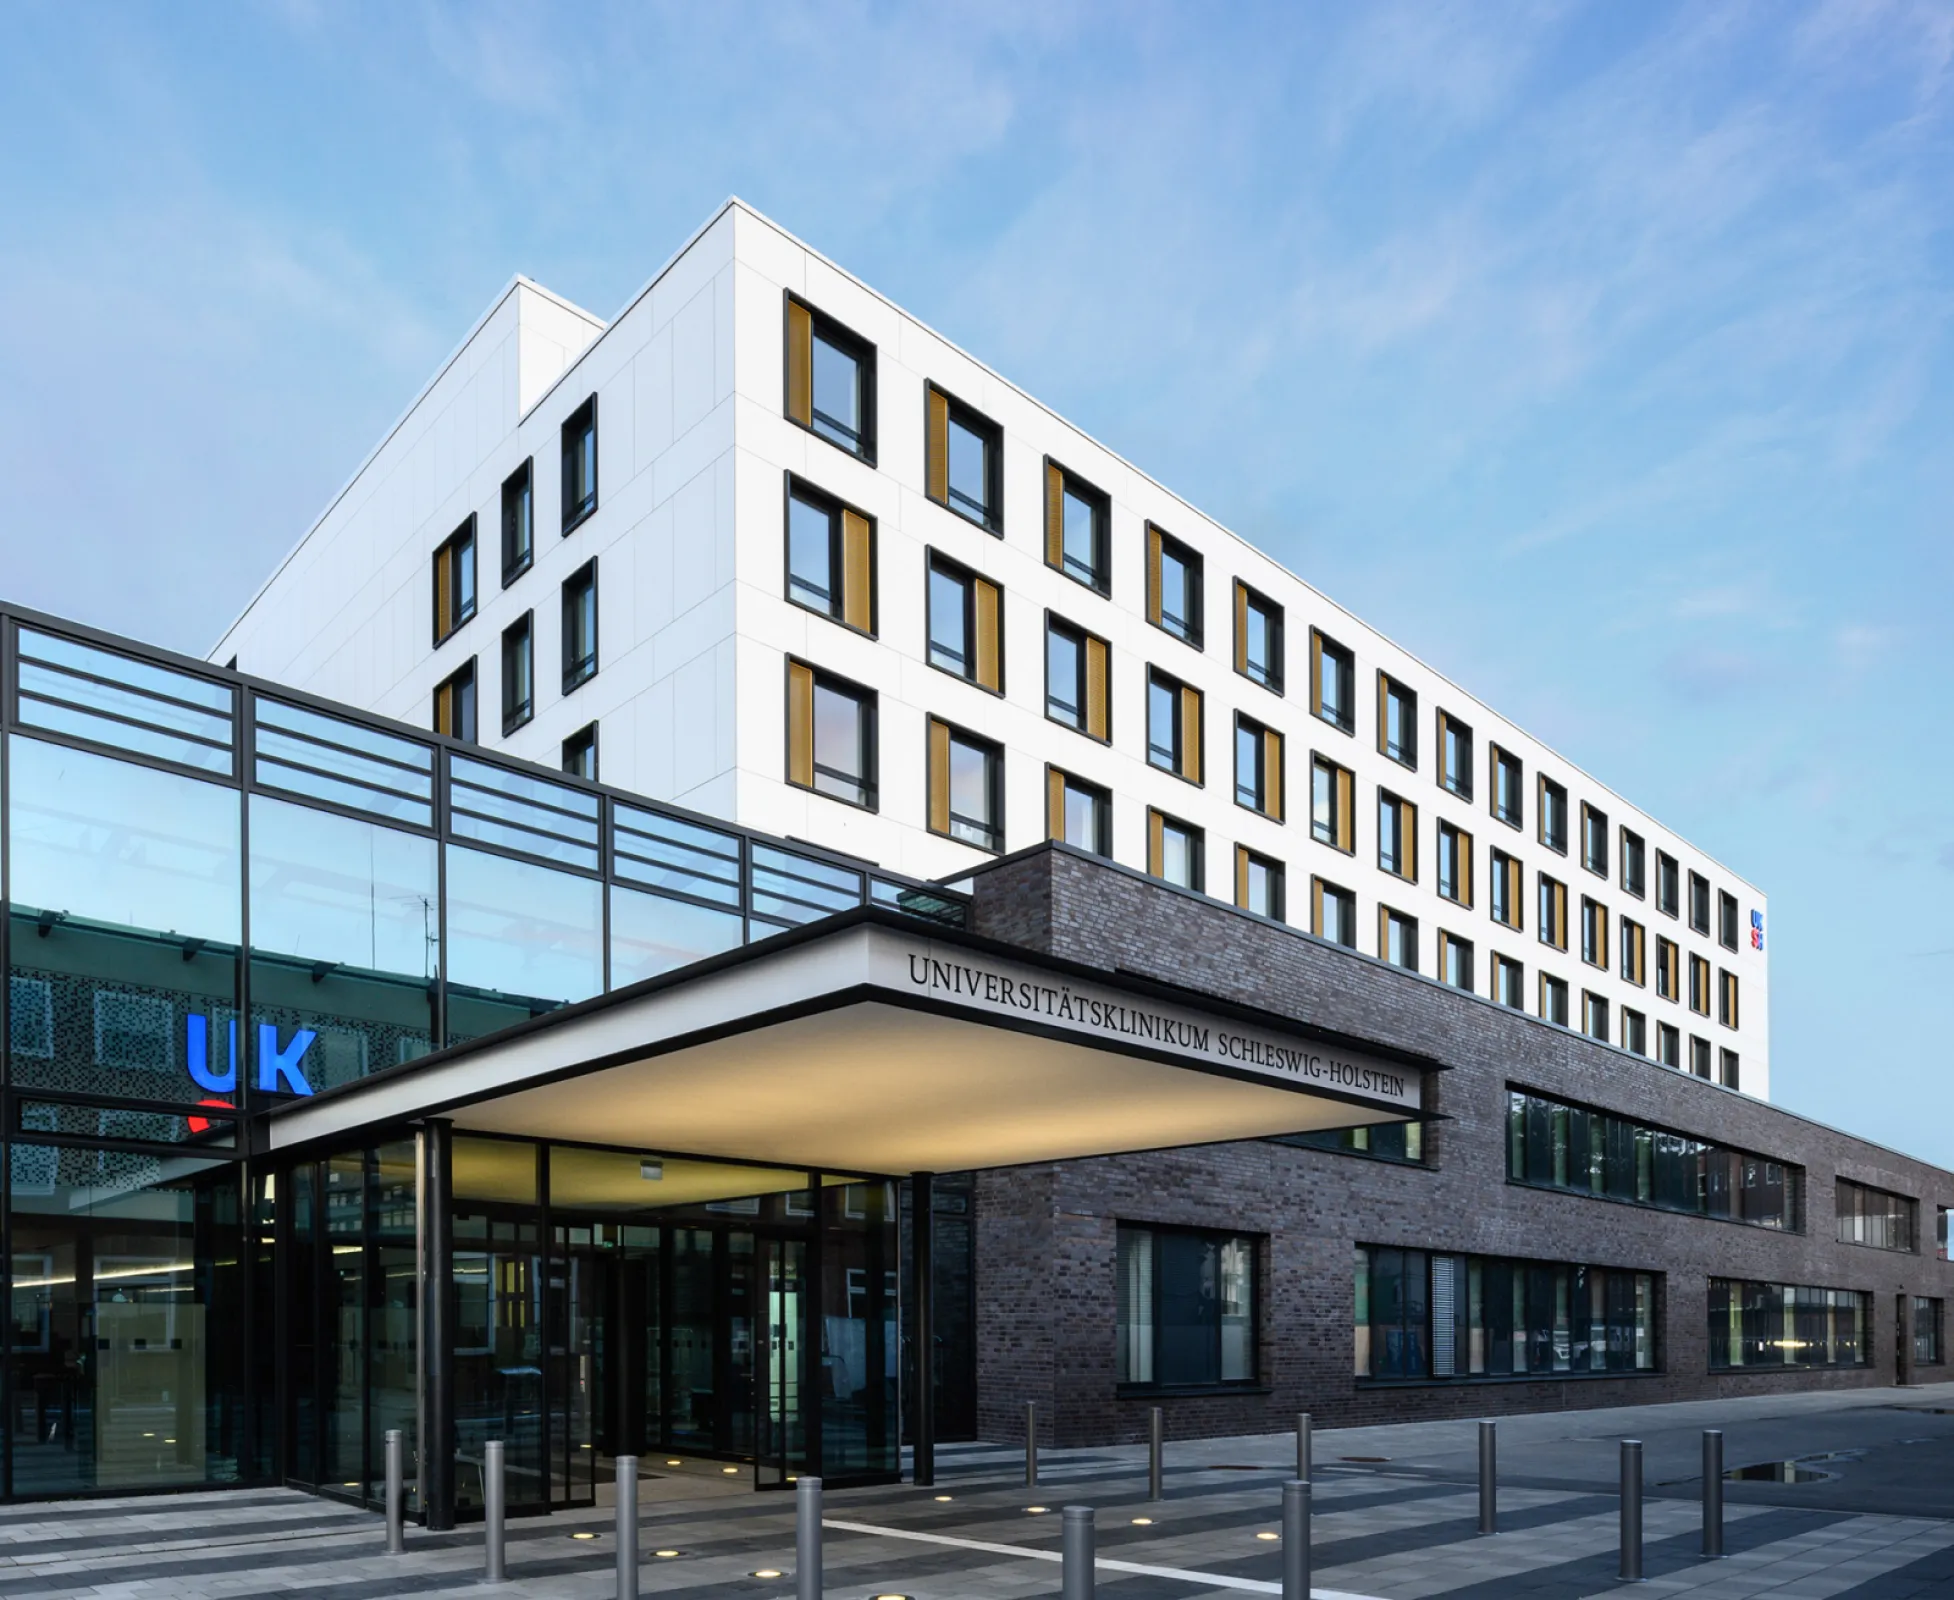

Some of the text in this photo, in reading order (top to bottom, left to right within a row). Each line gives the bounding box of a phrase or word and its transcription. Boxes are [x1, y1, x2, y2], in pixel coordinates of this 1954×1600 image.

[187, 1013, 317, 1096] UK
[908, 953, 1404, 1097] UNIVERSITÄTSKLINIKUM SCHLESWIG-HOLSTEIN
